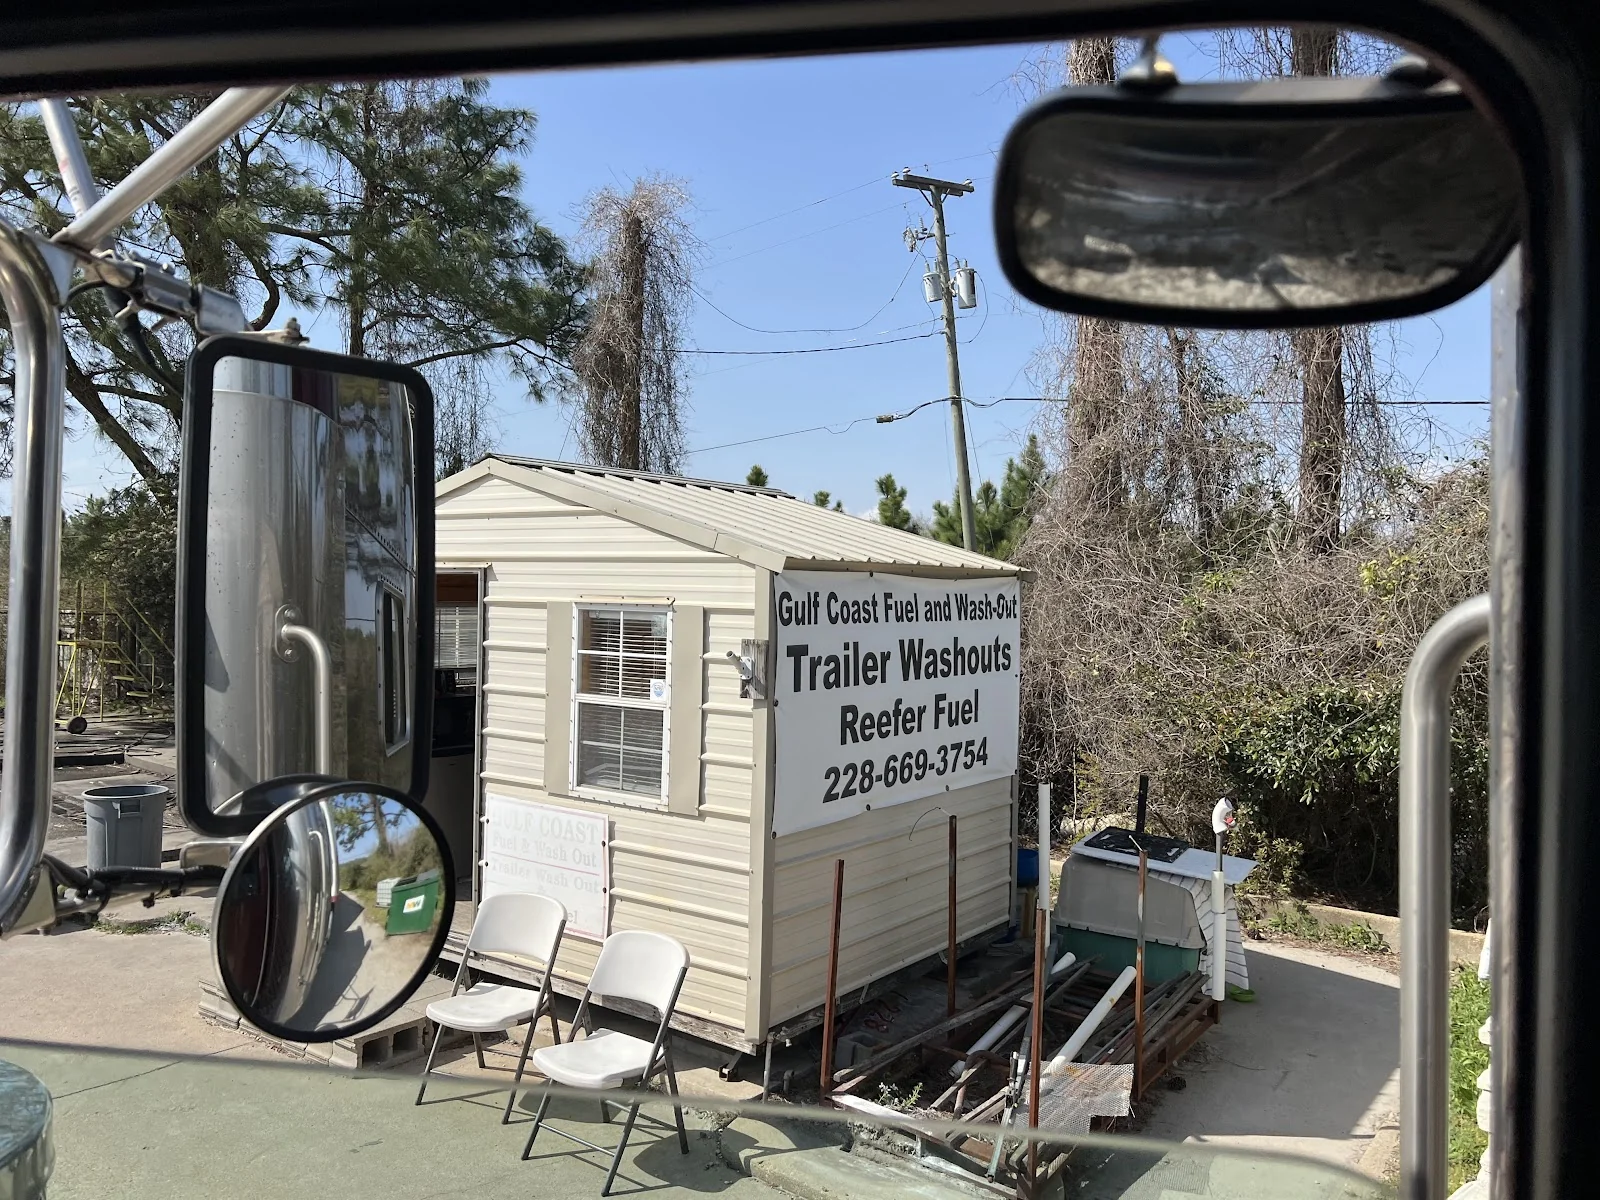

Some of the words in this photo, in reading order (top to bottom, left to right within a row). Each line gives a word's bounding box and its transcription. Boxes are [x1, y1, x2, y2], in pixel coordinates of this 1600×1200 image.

[778, 591, 820, 627] Gulf
[826, 591, 879, 625] Coast
[883, 592, 919, 623] Fuel
[924, 593, 952, 622] and
[954, 593, 1018, 621] Wash-Out
[786, 641, 892, 693] Trailer
[898, 634, 1012, 682] Washouts
[840, 697, 927, 746] Reefer
[933, 688, 979, 730] Fuel
[822, 736, 989, 803] 228-669-3754
[540, 815, 598, 845] COAST
[534, 841, 568, 862] Wash
[572, 847, 597, 868] Out
[536, 869, 568, 887] Wash
[574, 877, 600, 894] Out
